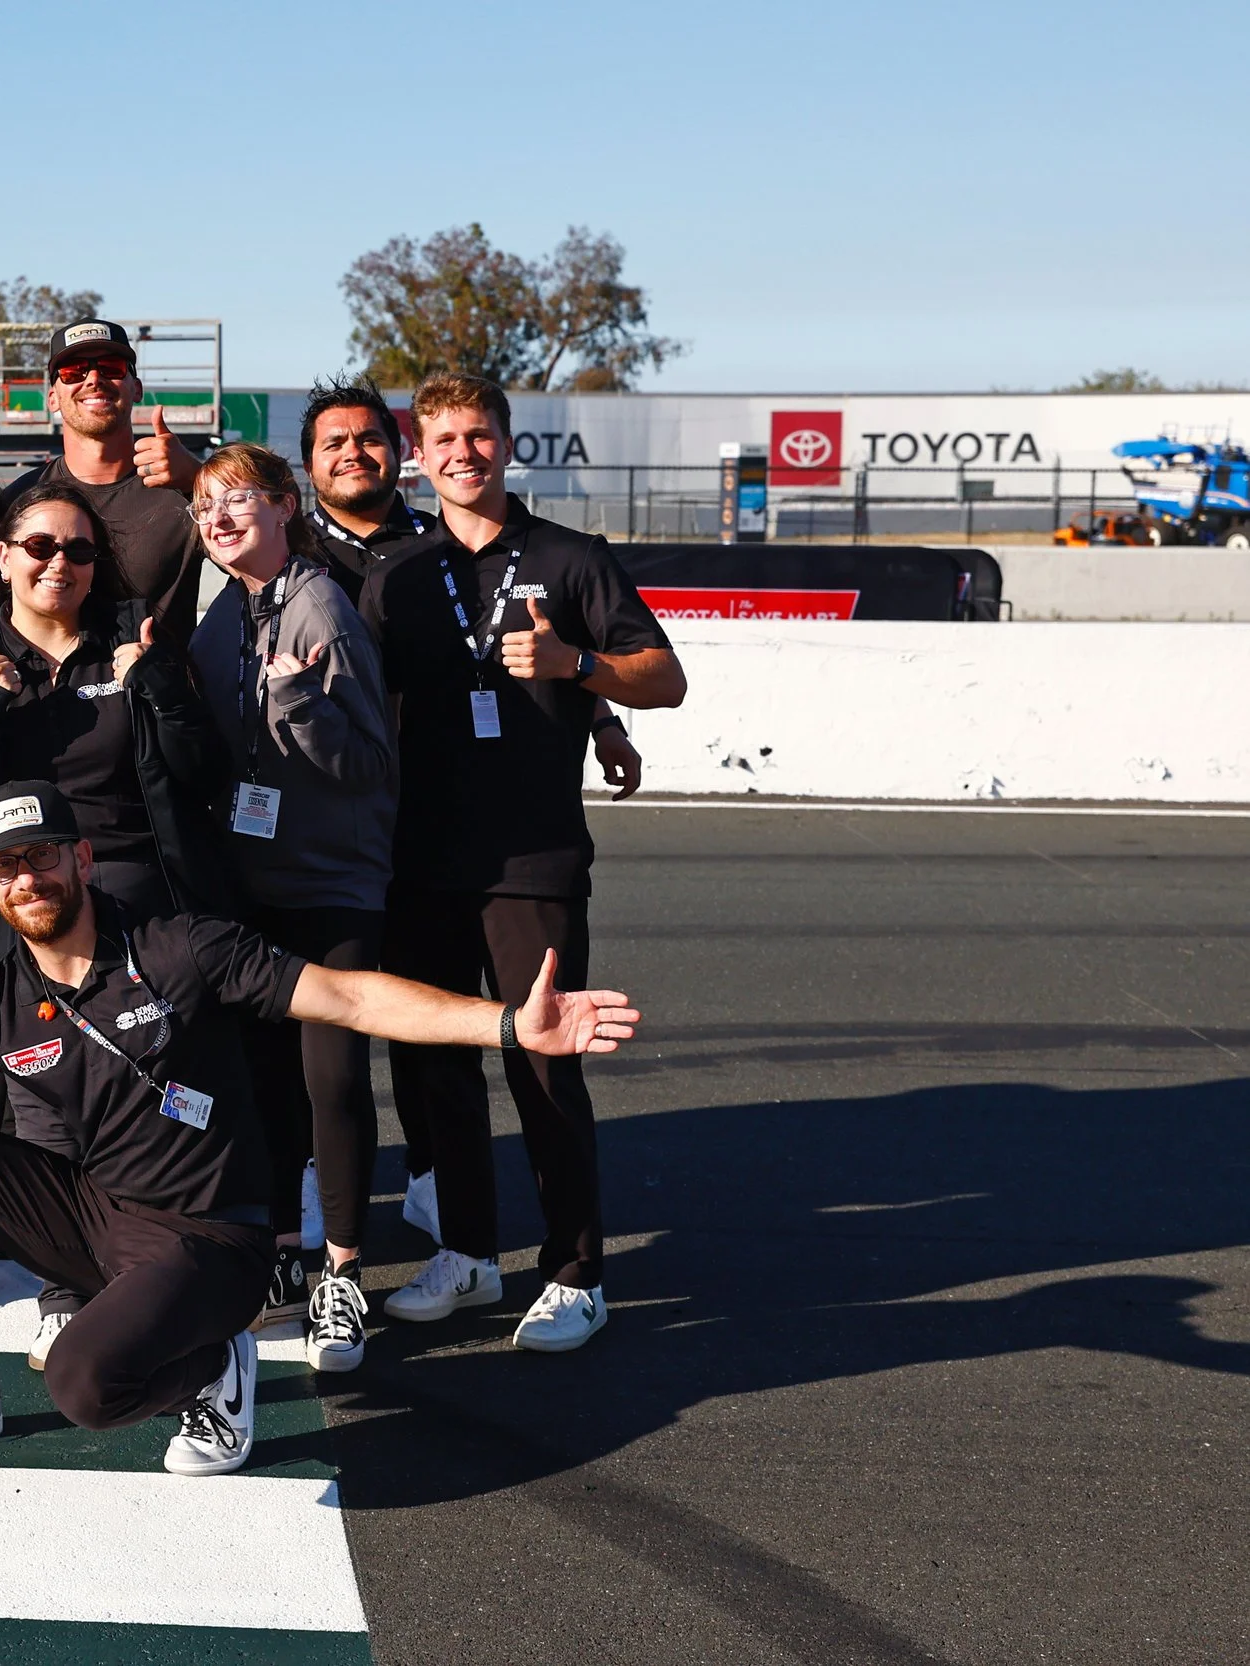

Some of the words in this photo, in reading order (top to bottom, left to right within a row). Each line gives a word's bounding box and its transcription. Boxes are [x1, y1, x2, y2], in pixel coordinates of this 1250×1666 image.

[513, 432, 590, 465] OTA
[861, 432, 1041, 464] TOYOTA
[512, 584, 544, 592] SONOMA
[87, 1026, 121, 1056] NASCAR
[24, 1058, 48, 1073] 350
